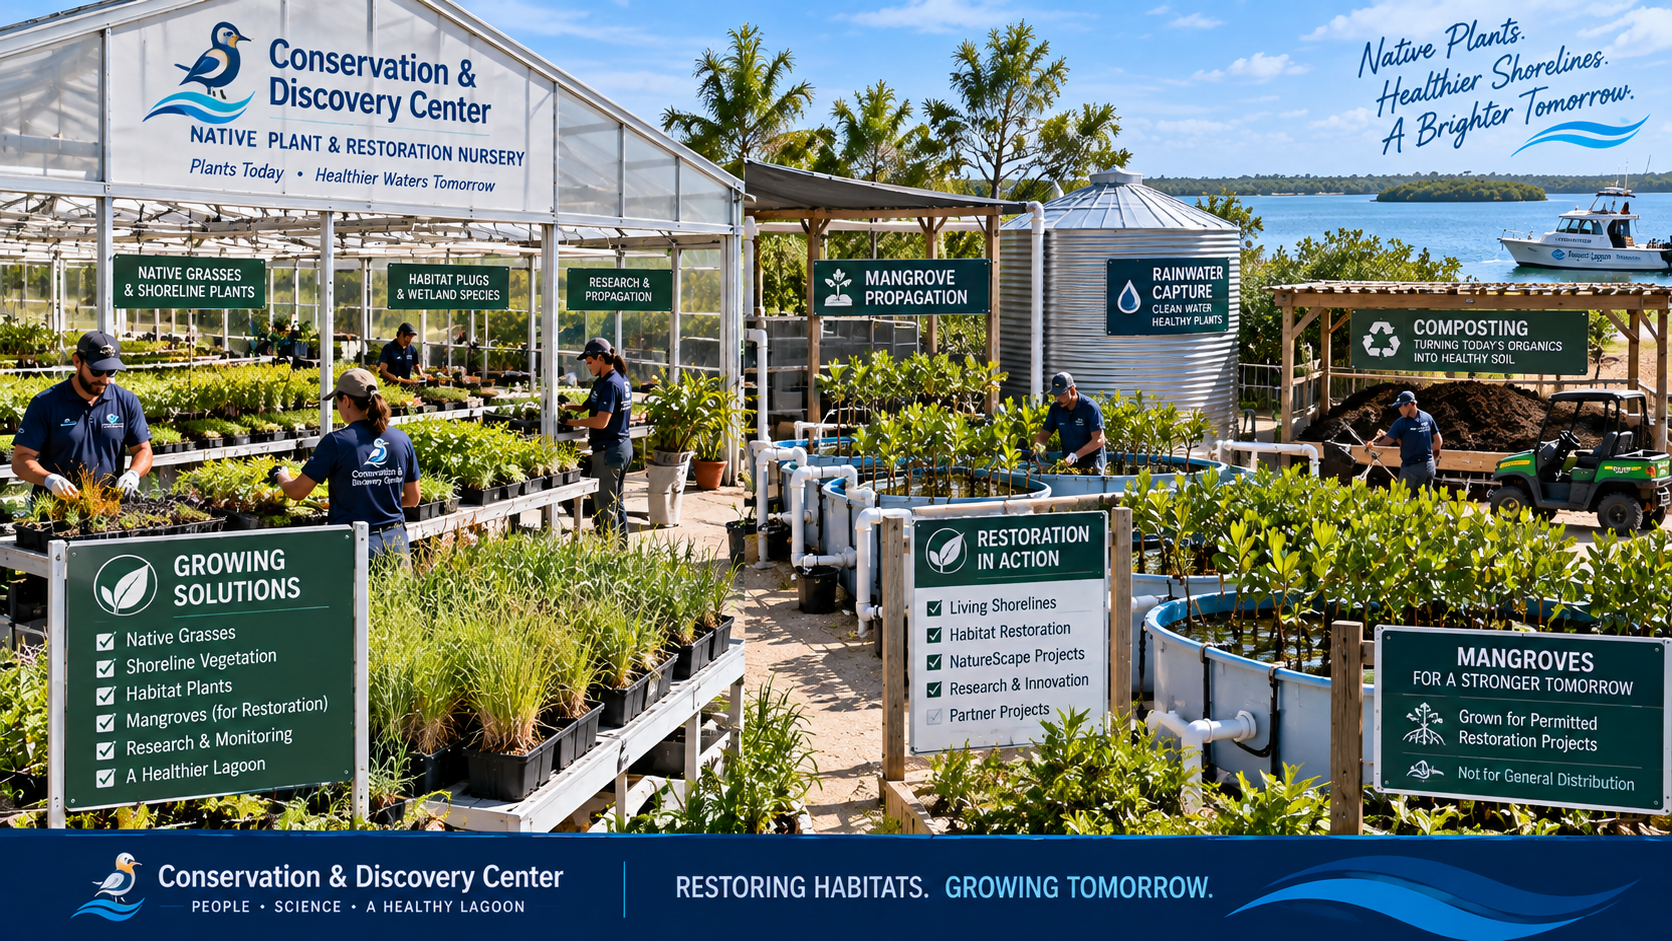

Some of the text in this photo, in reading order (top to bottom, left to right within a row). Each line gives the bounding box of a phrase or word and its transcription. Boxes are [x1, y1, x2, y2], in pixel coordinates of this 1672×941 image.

[269, 38, 477, 88] Conservation &
[269, 76, 491, 124] Discovery Center
[190, 125, 525, 167] NATIVE PLANT & RESTORATION NURSERY
[190, 158, 496, 193] Plants Today Healthier Waters Tomorrow
[138, 266, 242, 282] NATIVE GRASSES
[409, 273, 490, 286] HABITAT PLUGS
[589, 276, 650, 288] RESEARCH &
[865, 270, 955, 286] MANGROVE
[1152, 266, 1223, 281] RAINWATER
[124, 282, 255, 299] & SHORELINE PLANTS
[397, 288, 500, 301] & WETLAND SPECIES
[585, 290, 652, 302] PROPAGATION
[865, 289, 968, 306] PROPAGATION
[1152, 284, 1212, 299] CAPTURE
[1152, 304, 1212, 314] CLEAN WATER
[1152, 315, 1222, 326] HEALTHY PLANTS
[1414, 319, 1528, 336] COMPOSTING
[1414, 340, 1562, 352] TURNING TODAY'S ORGANICS
[1414, 353, 1515, 364] INTO HEALTHY SOIL
[978, 525, 1090, 547] RESTORATION
[174, 549, 286, 576] GROWING
[978, 550, 1059, 570] IN ACTION
[174, 577, 300, 607] SOLUTIONS
[950, 596, 1056, 616] Living Shorelines
[126, 626, 236, 648] Native Grasses
[950, 622, 1070, 642] Habitat Restoration
[126, 648, 277, 674] Shoreline Vegetation
[950, 648, 1085, 669] NatureScape Projects
[1457, 646, 1594, 672] MANGROVES
[126, 678, 232, 702] Habitat Plants
[950, 674, 1089, 696] Research & Innovation
[1413, 670, 1634, 696] FOR A STRONGER TOMORROW
[126, 695, 328, 730] Mangroves (for Restoration)
[950, 703, 1050, 722] Partner Projects
[1459, 710, 1598, 731] Grown for Permitted
[126, 727, 293, 756] Research & Monitoring
[1459, 730, 1598, 753] Restoration Projects
[126, 758, 266, 784] A Healthier Lagoon
[1458, 766, 1635, 791] Not for General Distribution
